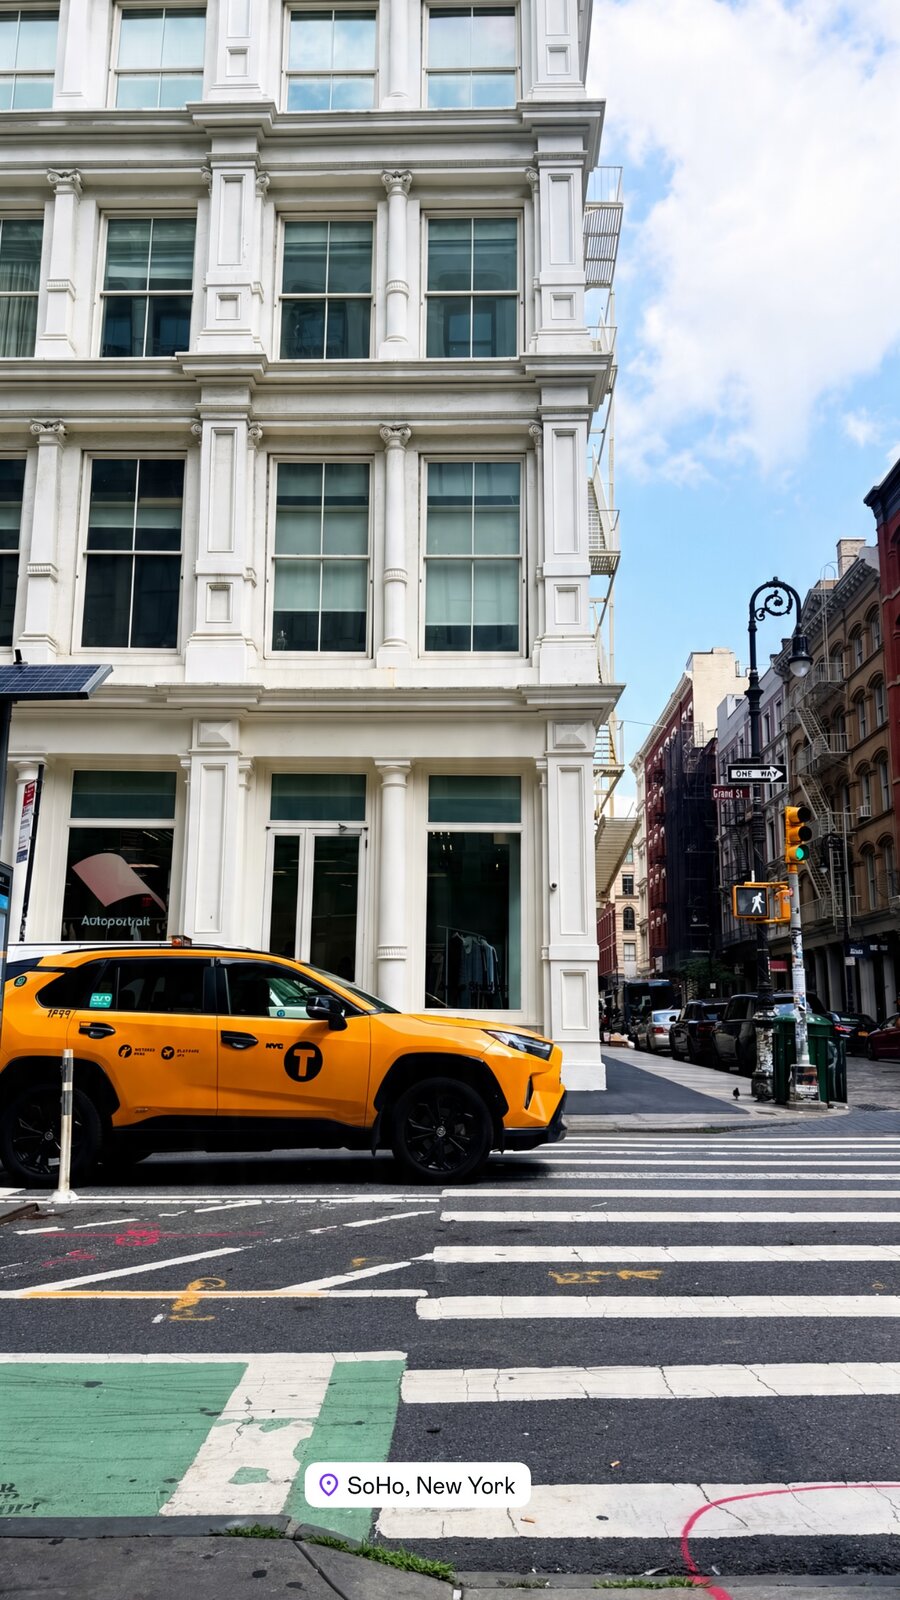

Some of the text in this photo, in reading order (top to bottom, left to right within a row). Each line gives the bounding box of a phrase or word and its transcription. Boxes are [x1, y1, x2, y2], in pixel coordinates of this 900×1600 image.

[735, 770, 778, 778] ONE WAY
[712, 788, 744, 799] Grand St
[80, 914, 151, 929] Autoportrait
[265, 1042, 284, 1050] NYC
[293, 1048, 316, 1077] T
